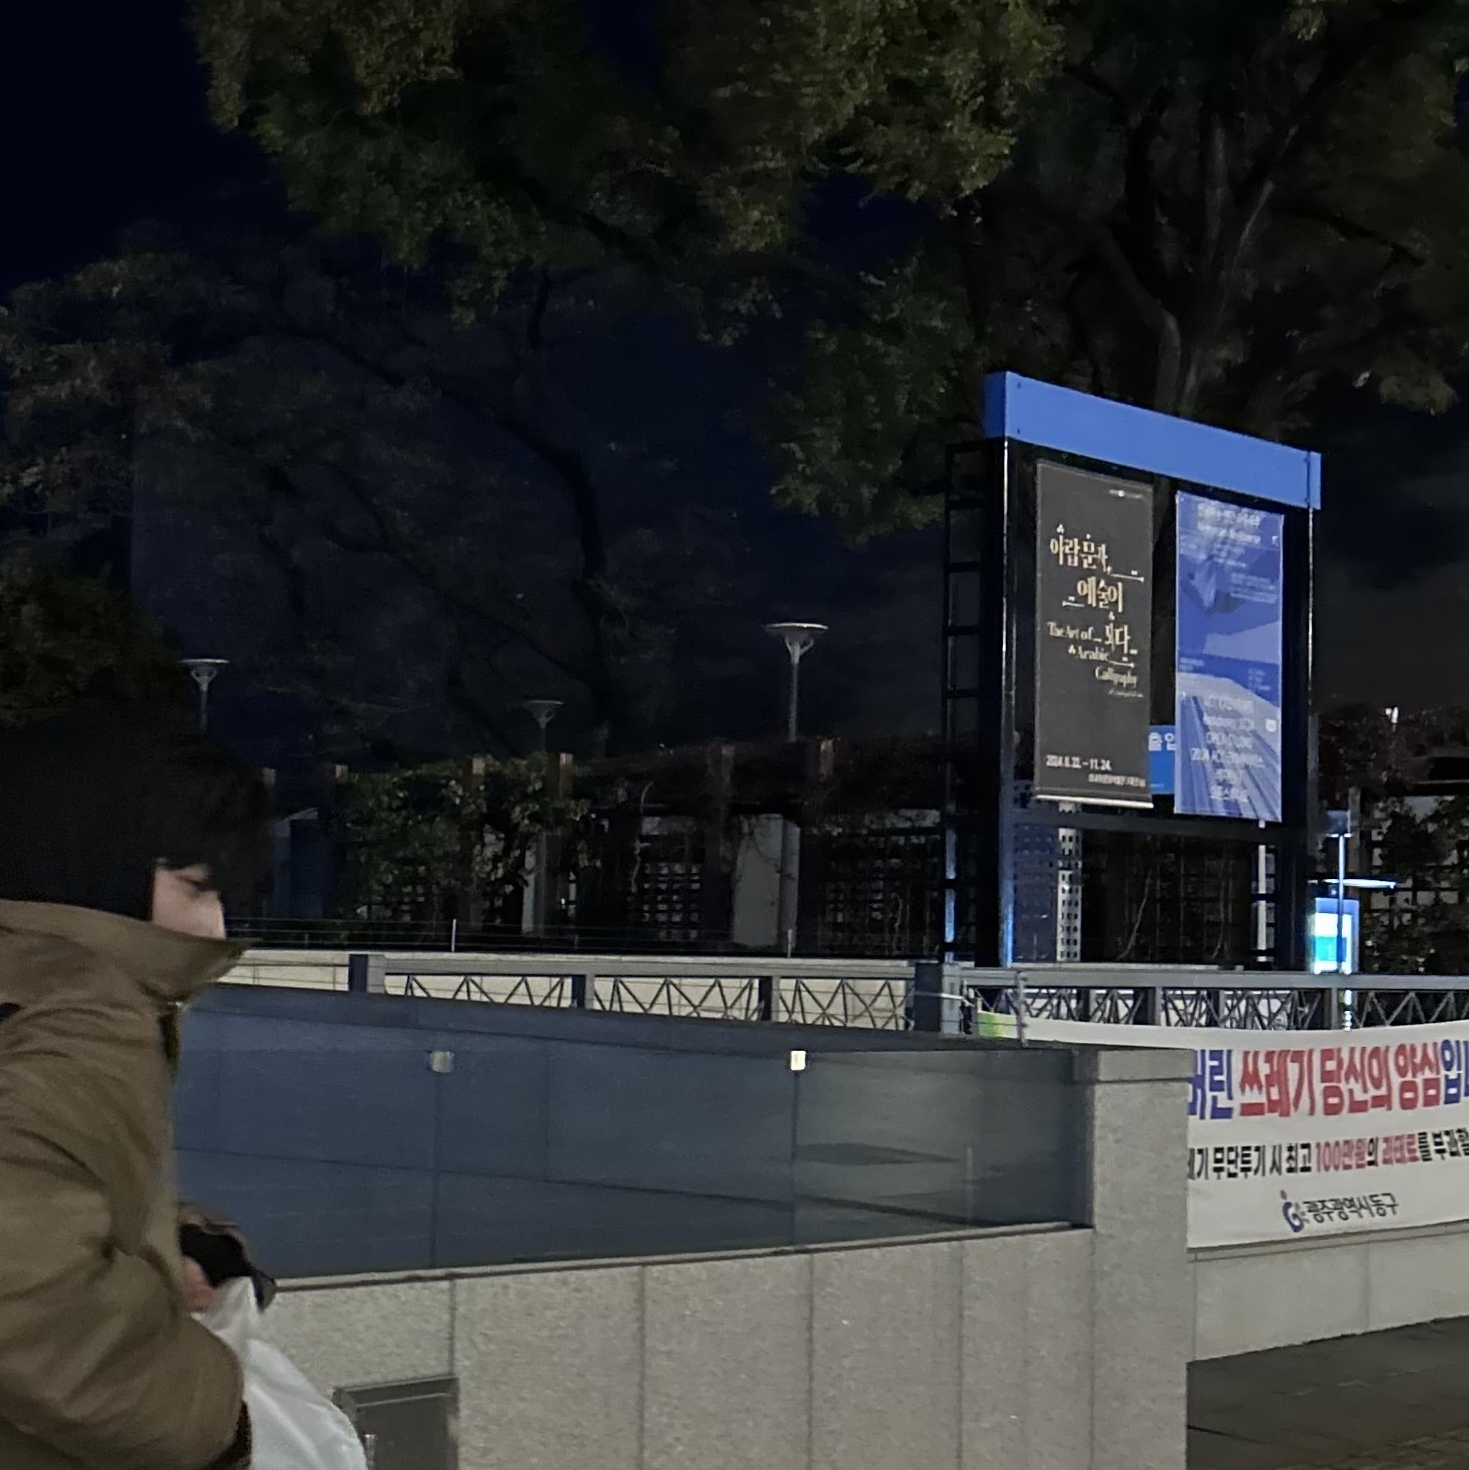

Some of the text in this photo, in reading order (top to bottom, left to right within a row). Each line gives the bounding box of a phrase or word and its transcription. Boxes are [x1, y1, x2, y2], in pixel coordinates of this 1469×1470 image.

[1077, 576, 1124, 613] 예술이
[1239, 1048, 1315, 1118] 쓰레기
[1320, 1045, 1393, 1116] 당신의
[1213, 1145, 1266, 1180] 무단투기
[1270, 1143, 1283, 1176] 시
[1286, 1143, 1312, 1174] 최고
[1316, 1136, 1379, 1172] 100만원의
